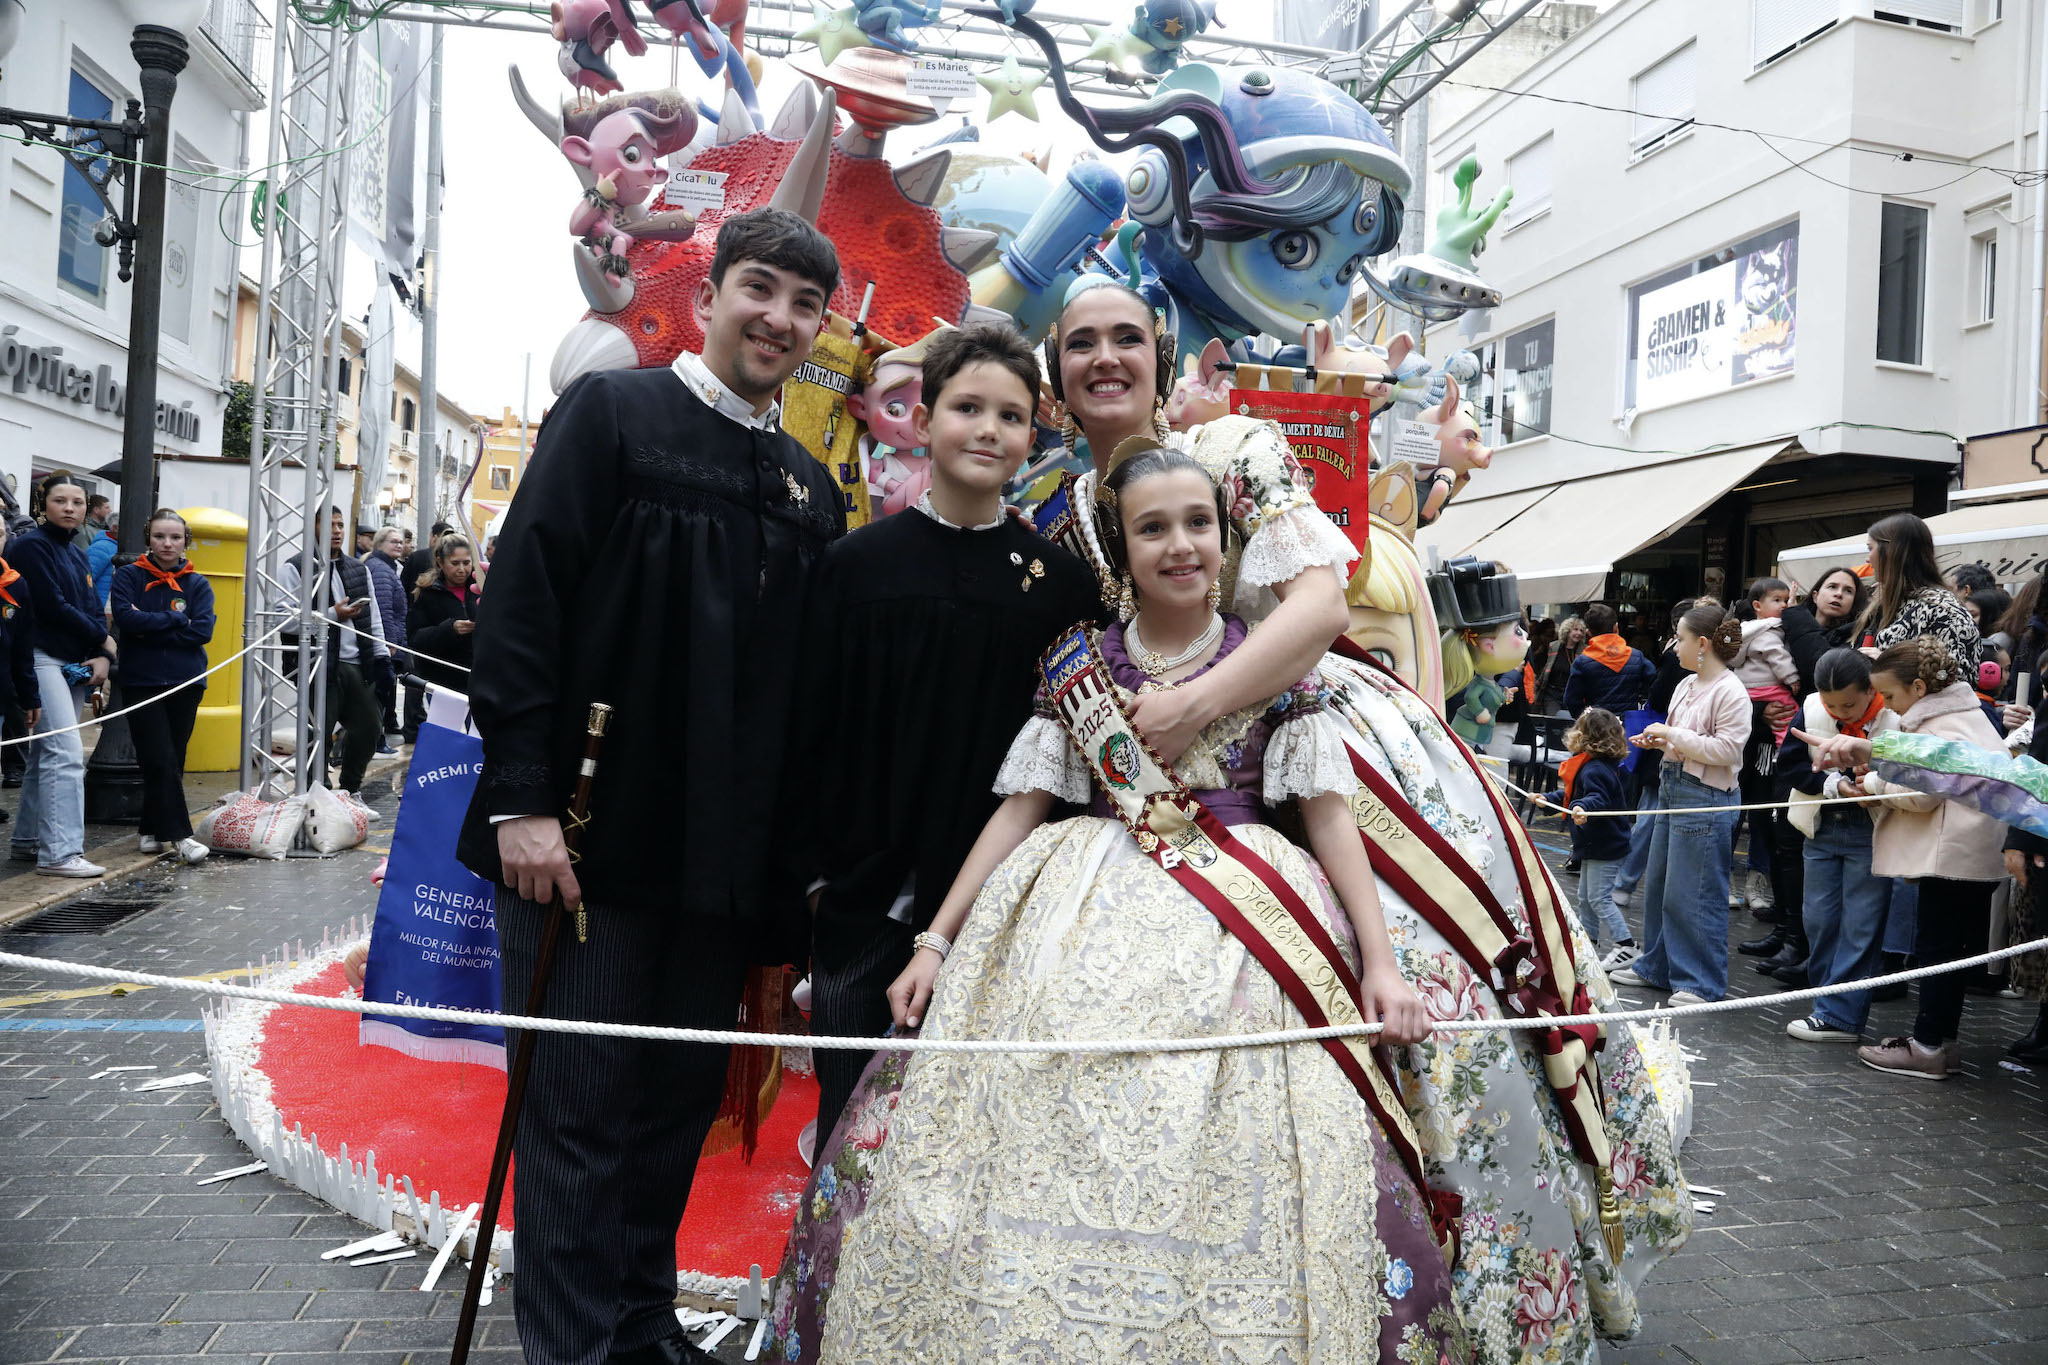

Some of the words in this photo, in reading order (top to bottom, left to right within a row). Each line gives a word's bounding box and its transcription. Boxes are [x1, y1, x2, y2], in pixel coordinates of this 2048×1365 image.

[938, 62, 969, 72] Maries
[1647, 300, 1711, 350] ¿RAMEN
[1714, 299, 1726, 328] &
[0, 325, 95, 404] óptica
[1524, 340, 1538, 367] TU
[1647, 337, 1698, 380] SUSHI?
[1313, 424, 1324, 437] DE
[1324, 423, 1345, 439] DÉNIA
[1288, 444, 1315, 460] OCAL
[1316, 445, 1351, 480] FALLERA
[1077, 697, 1114, 746] 2025
[416, 763, 469, 789] PREMI
[413, 900, 501, 933] VALENCIA
[1225, 874, 1313, 965] Fallera
[399, 931, 440, 950] MILLOR
[440, 938, 473, 956] FALLA
[421, 950, 441, 965] DEL
[444, 953, 494, 970] MUNICIPI
